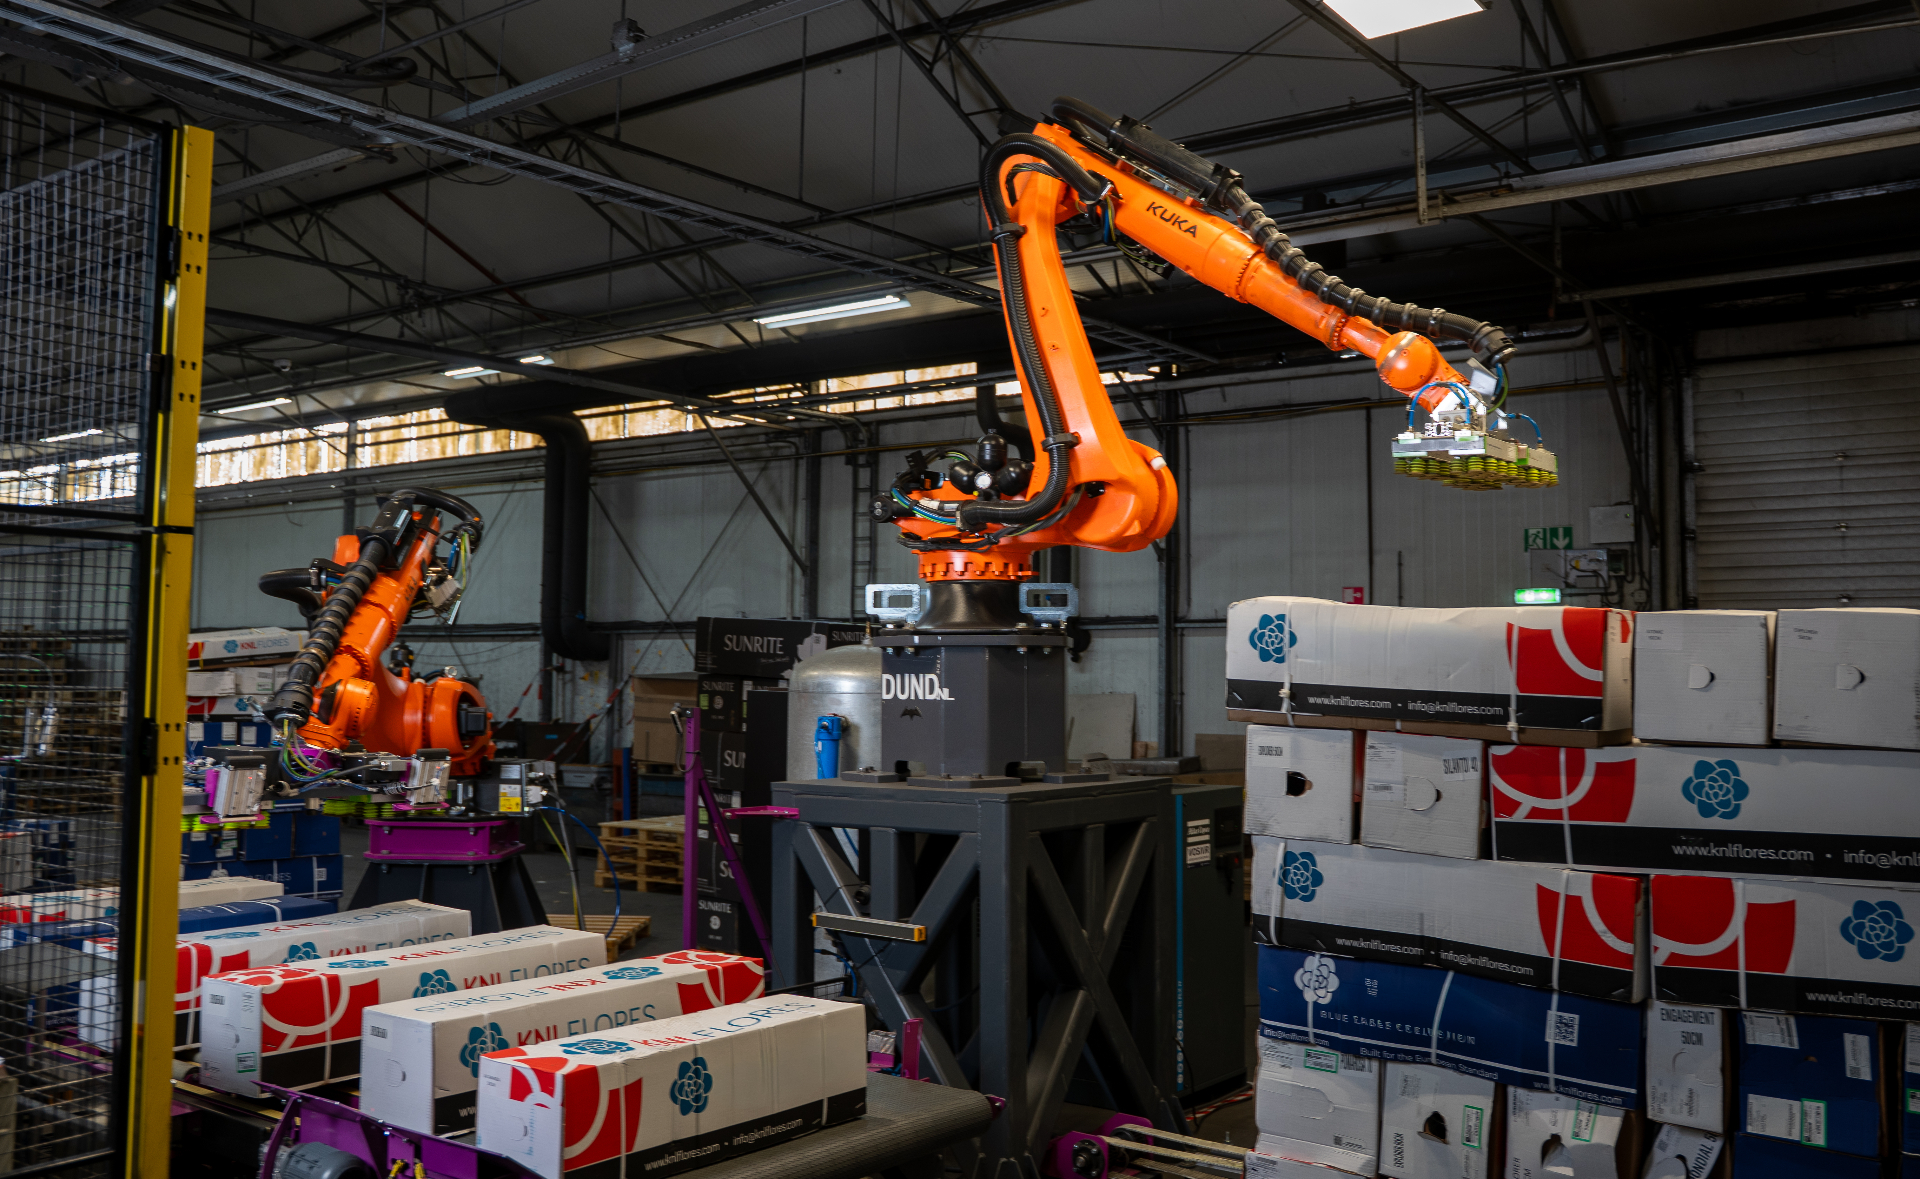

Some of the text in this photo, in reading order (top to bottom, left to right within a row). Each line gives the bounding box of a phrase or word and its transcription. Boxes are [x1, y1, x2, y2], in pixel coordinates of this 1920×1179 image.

[1146, 201, 1197, 238] KUKA
[240, 641, 258, 650] KNL
[724, 634, 784, 654] SUNRITE
[702, 681, 735, 692] SUNRITE
[881, 673, 940, 700] DUND
[1307, 695, 1504, 715] www.knlflores.com info@knlflores.com
[1671, 843, 1814, 861] www.knlflores.com
[698, 899, 732, 913] SUNRITE
[389, 949, 462, 961] KNL
[1335, 936, 1534, 976] www.knlflores.com info@knlflores.com
[691, 1002, 816, 1037] FLORES
[1319, 1010, 1349, 1023] BLUE
[1660, 1007, 1716, 1025] ENGAGEMENT
[1359, 1046, 1381, 1058] Built
[1382, 1050, 1396, 1060] for
[1396, 1053, 1414, 1062] the
[1457, 1063, 1500, 1081] Standard
[643, 1117, 804, 1172] www.knlflores.com info@knlflores.com
